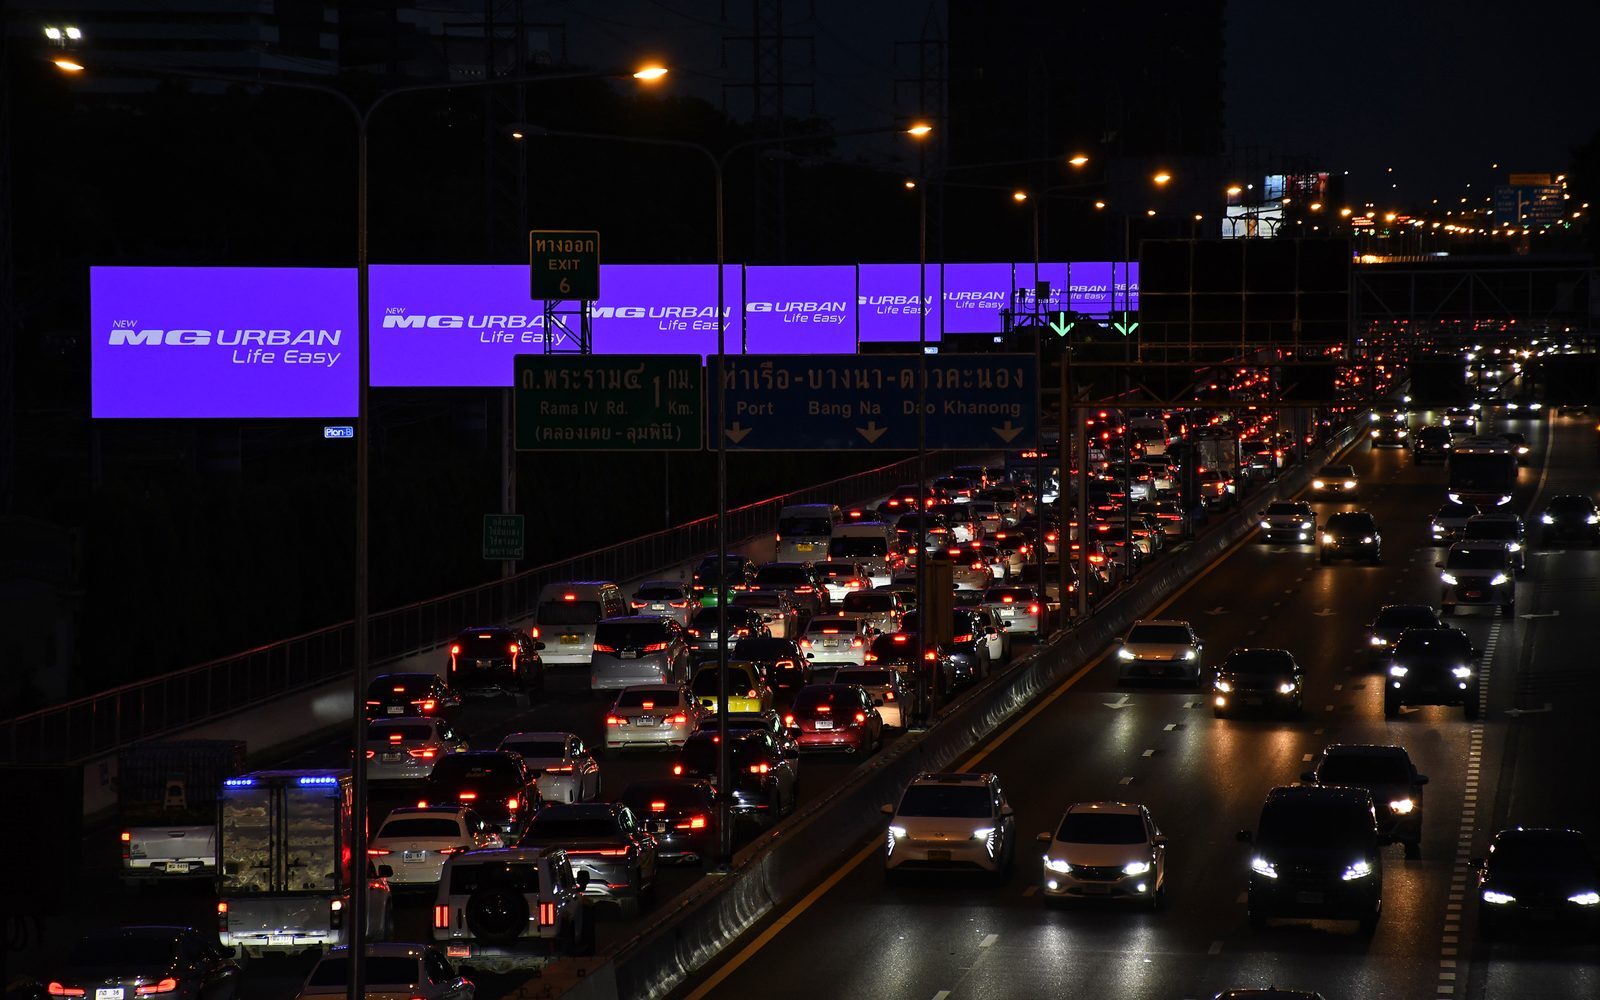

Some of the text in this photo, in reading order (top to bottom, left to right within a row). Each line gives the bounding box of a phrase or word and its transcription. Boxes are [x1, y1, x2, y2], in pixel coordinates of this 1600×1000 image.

[535, 239, 594, 253] ทางออก
[548, 259, 581, 271] EXIT
[559, 277, 571, 294] 6
[948, 291, 1005, 301] URBAN
[775, 302, 847, 312] URBAN
[877, 306, 899, 314] Life
[955, 301, 1005, 310] Life Easy
[112, 320, 138, 328] NEW
[382, 315, 464, 328] MG
[783, 313, 847, 324] Life Easy
[658, 320, 688, 331] Life
[108, 329, 342, 346] MG URBAN
[480, 331, 515, 343] Life
[232, 350, 341, 367] Life Easy
[652, 375, 662, 409] 1
[667, 368, 695, 391] กม.
[540, 401, 694, 416] Rama IV Rd. Km.
[736, 400, 775, 416] Port
[808, 400, 881, 419] Bang Na
[943, 400, 1021, 418] Khanong
